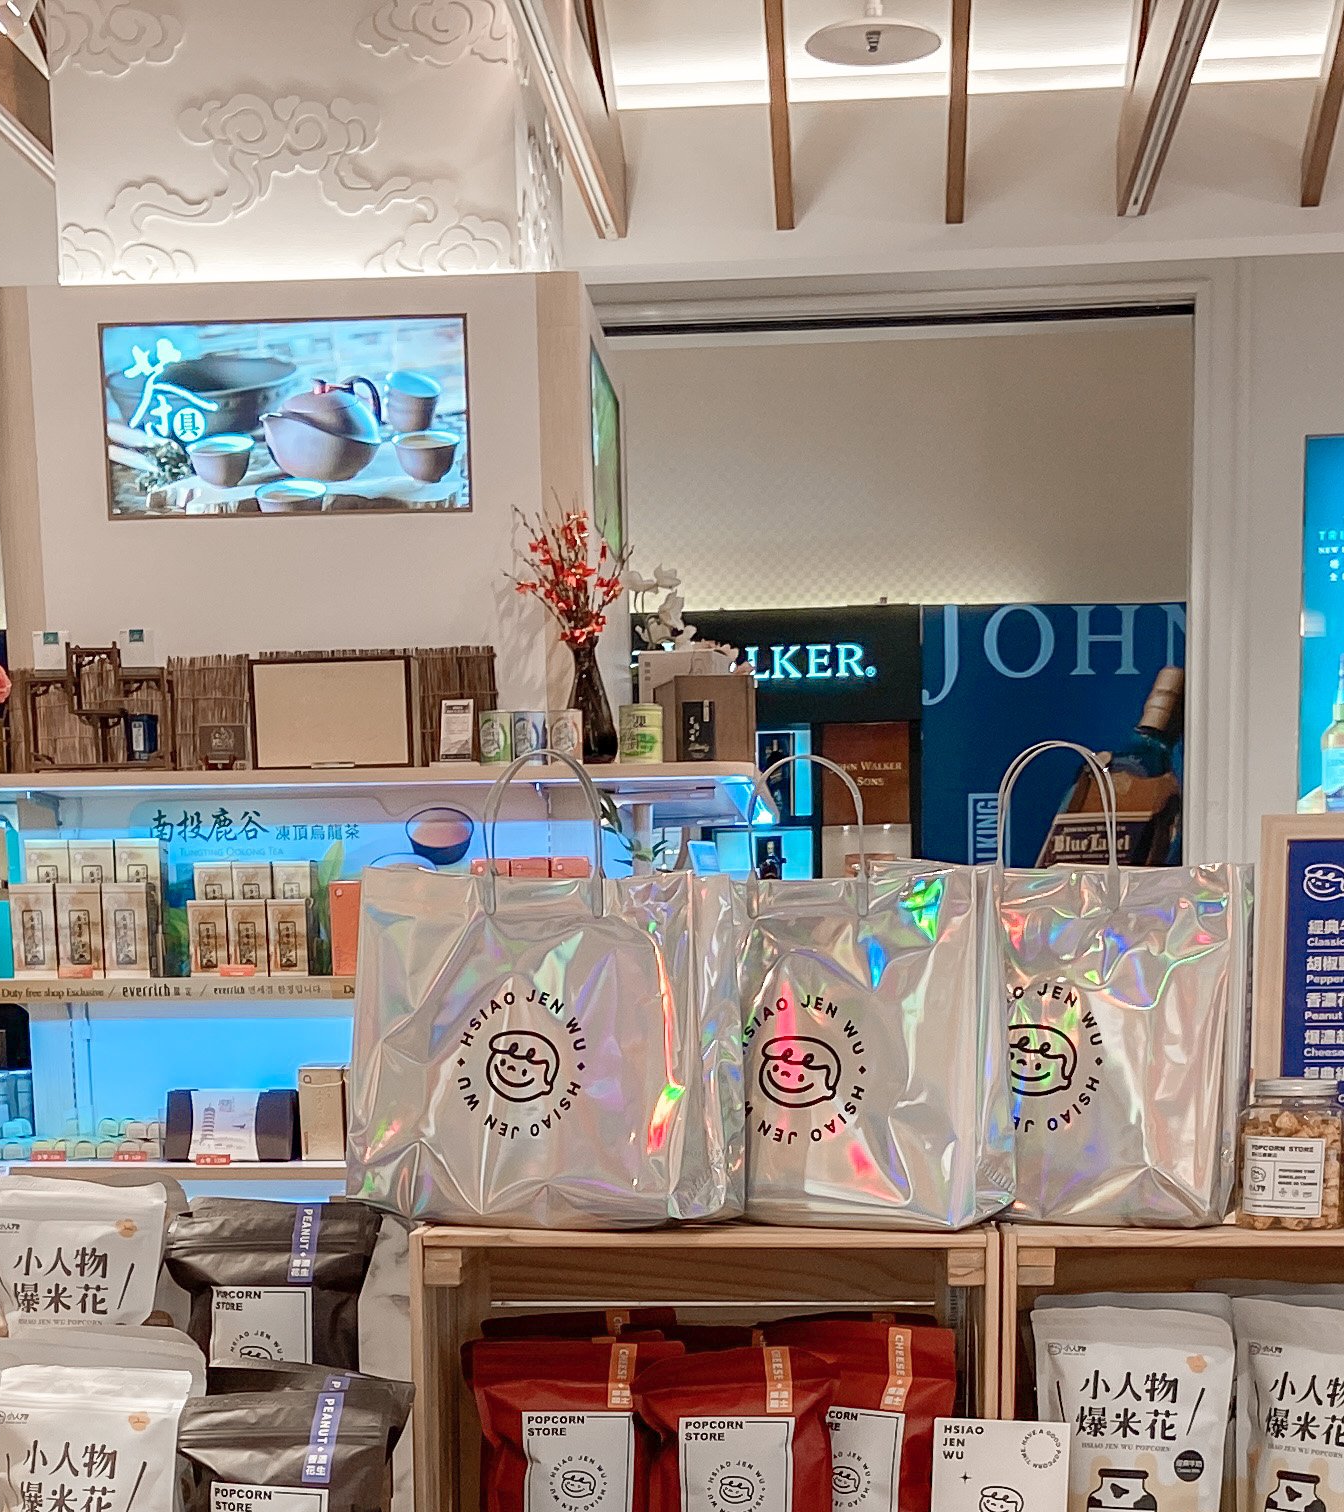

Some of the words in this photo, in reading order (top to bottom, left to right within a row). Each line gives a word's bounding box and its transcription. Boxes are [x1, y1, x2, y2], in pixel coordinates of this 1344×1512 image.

[860, 760, 902, 771] WALKER
[149, 807, 270, 843] 南投鹿谷
[275, 823, 360, 842] 凍頂烏龍茶
[268, 846, 284, 856] TEA
[1053, 833, 1087, 853] Blue
[1088, 833, 1130, 853] Lael
[1306, 974, 1344, 986] Pepper
[1, 988, 24, 999] Duty
[43, 988, 64, 999] shop
[122, 985, 171, 998] everrich
[459, 992, 516, 1047] HSIAO
[525, 989, 565, 1015] JEN
[566, 1016, 587, 1052] WU
[1037, 983, 1080, 1009] JEN
[1082, 1012, 1105, 1047] WU
[1304, 1010, 1343, 1020] Peanut
[801, 994, 840, 1017] JEN
[843, 1021, 865, 1056] WU
[1304, 1047, 1344, 1058] Cheese
[457, 1077, 481, 1112] WU
[529, 1081, 582, 1138] HSIAO
[809, 1084, 866, 1142] HSIAO
[484, 1116, 521, 1140] JEN
[757, 1121, 799, 1145] JEN
[299, 1208, 314, 1250] PEANUT
[13, 1247, 108, 1279] 小人物
[13, 1282, 109, 1315] 爆米花
[215, 1301, 244, 1312] STORE
[895, 1334, 906, 1376] CHEESE
[1079, 1369, 1179, 1404] 小人物
[316, 1397, 336, 1445] PEANUT
[527, 1415, 585, 1425] POPCORN
[826, 1410, 858, 1421] CORN
[1075, 1405, 1179, 1441] 爆米花
[527, 1427, 567, 1437] STORE
[685, 1420, 744, 1430] POPCORN
[943, 1424, 985, 1435] HSIAO
[685, 1432, 725, 1441] STORE
[942, 1437, 966, 1447] JEN
[22, 1439, 117, 1480] 小人物
[942, 1450, 964, 1460] WU
[214, 1487, 273, 1501] POPCORN
[215, 1501, 253, 1512] STORE
